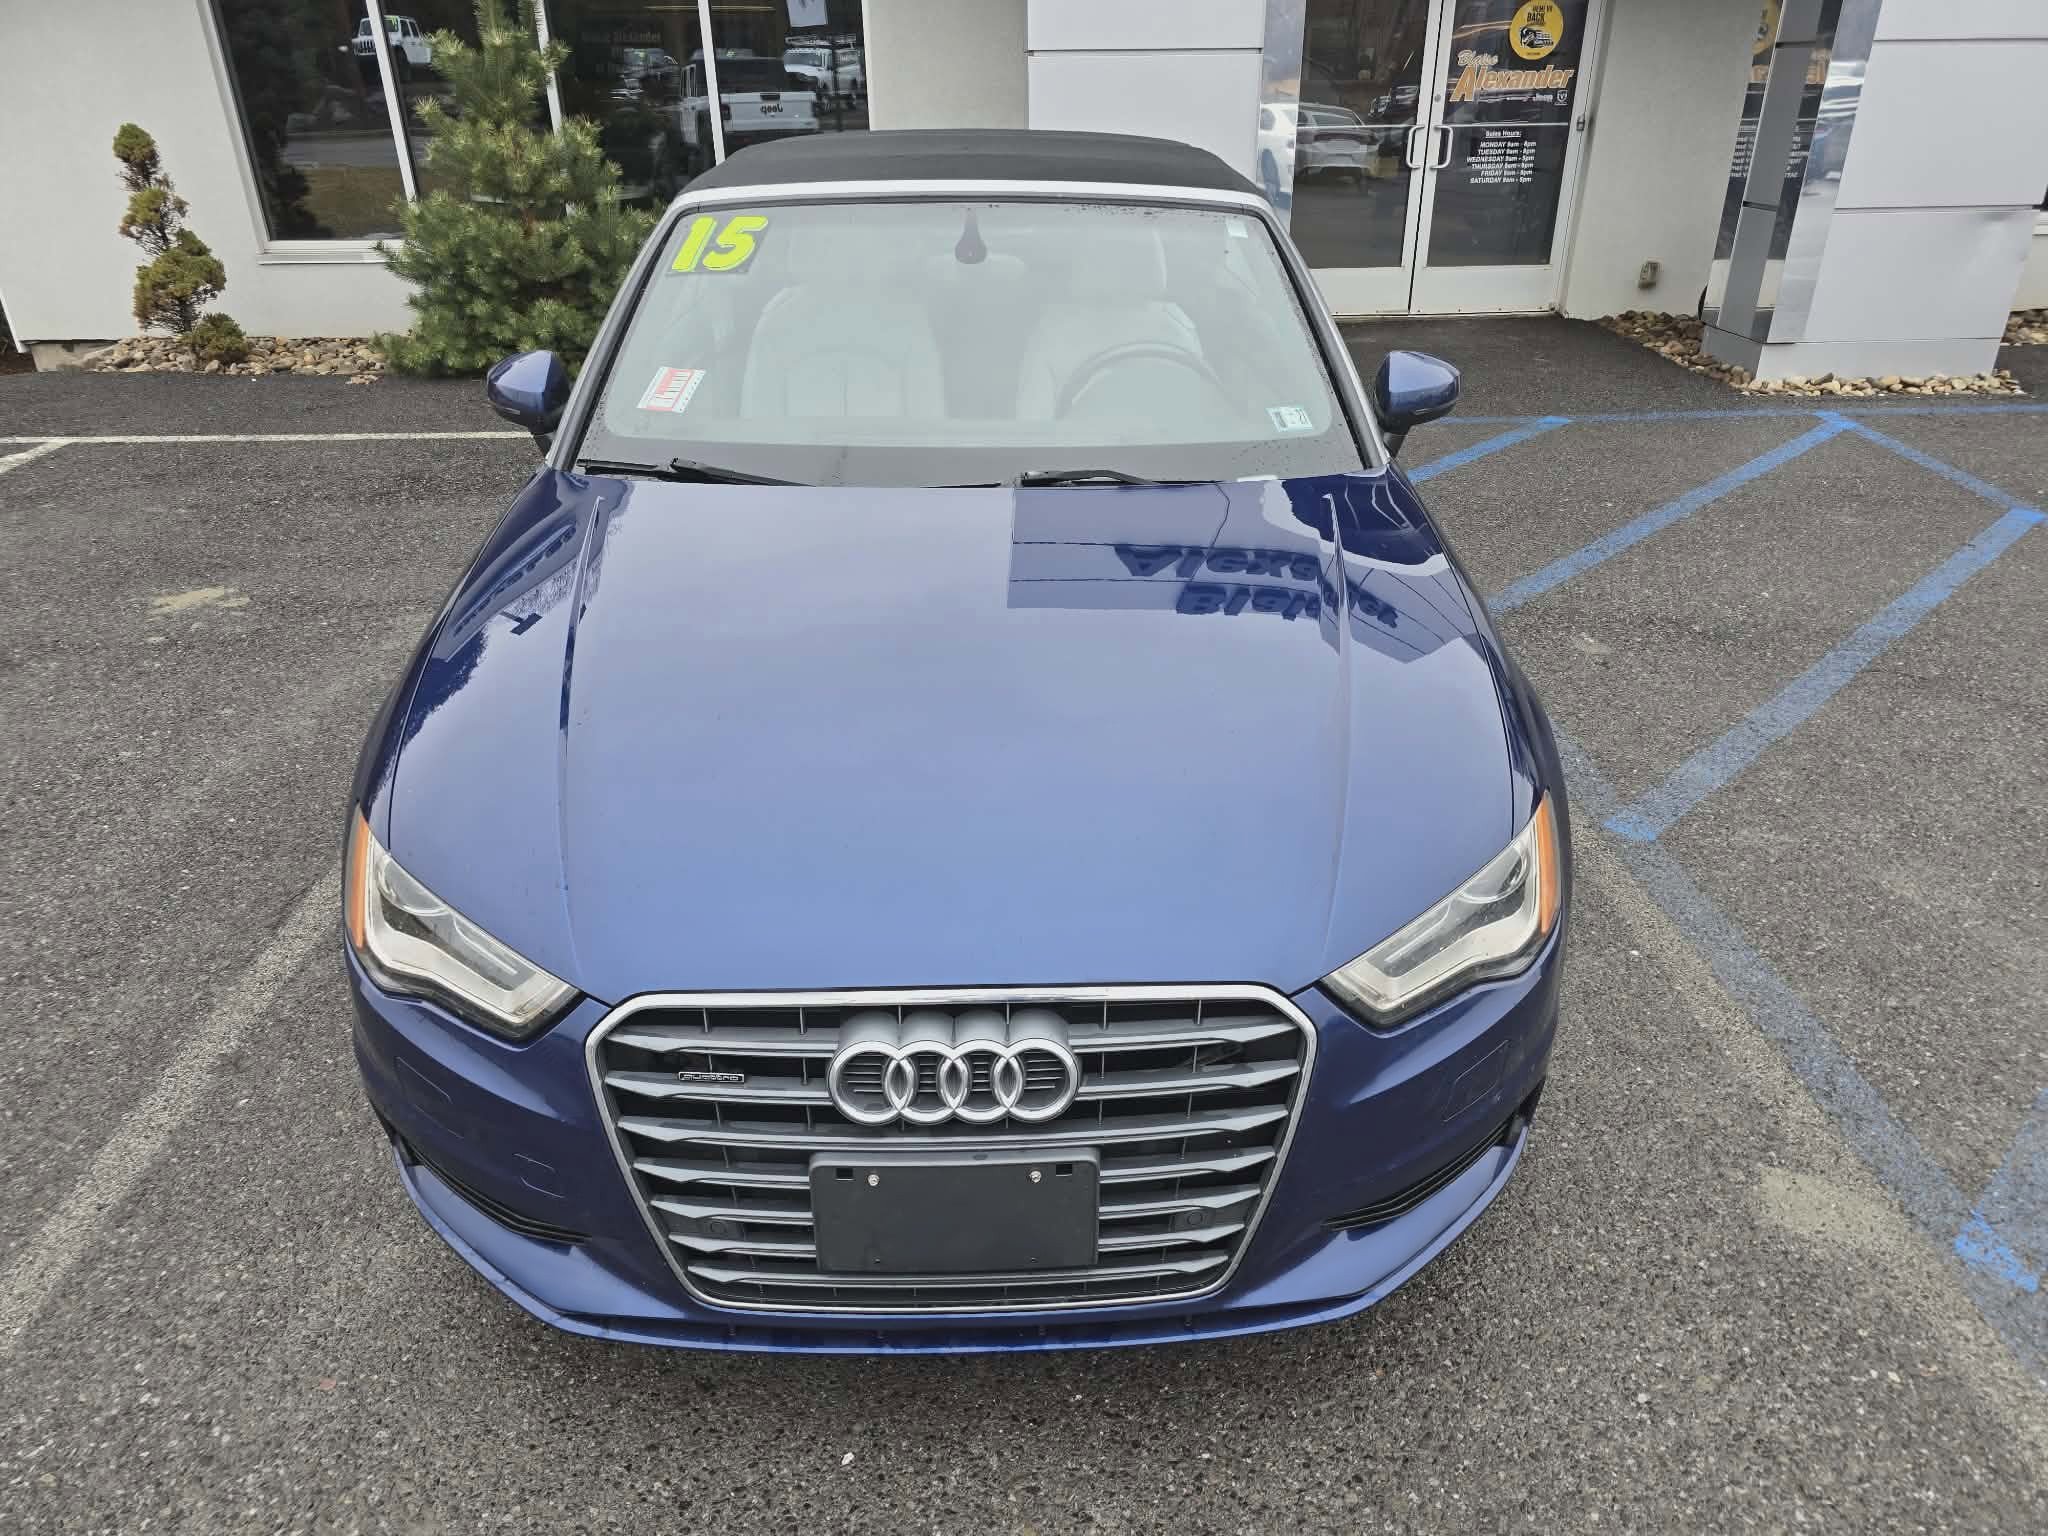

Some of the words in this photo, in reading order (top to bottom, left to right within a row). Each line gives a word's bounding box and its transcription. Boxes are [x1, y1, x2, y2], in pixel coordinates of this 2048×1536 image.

[1449, 64, 1575, 102] Alexander
[1466, 155, 1504, 163] WEDNESDAY
[1472, 162, 1503, 170] THURSDAY
[1480, 169, 1503, 177] FRIDAY
[671, 215, 769, 273] 15
